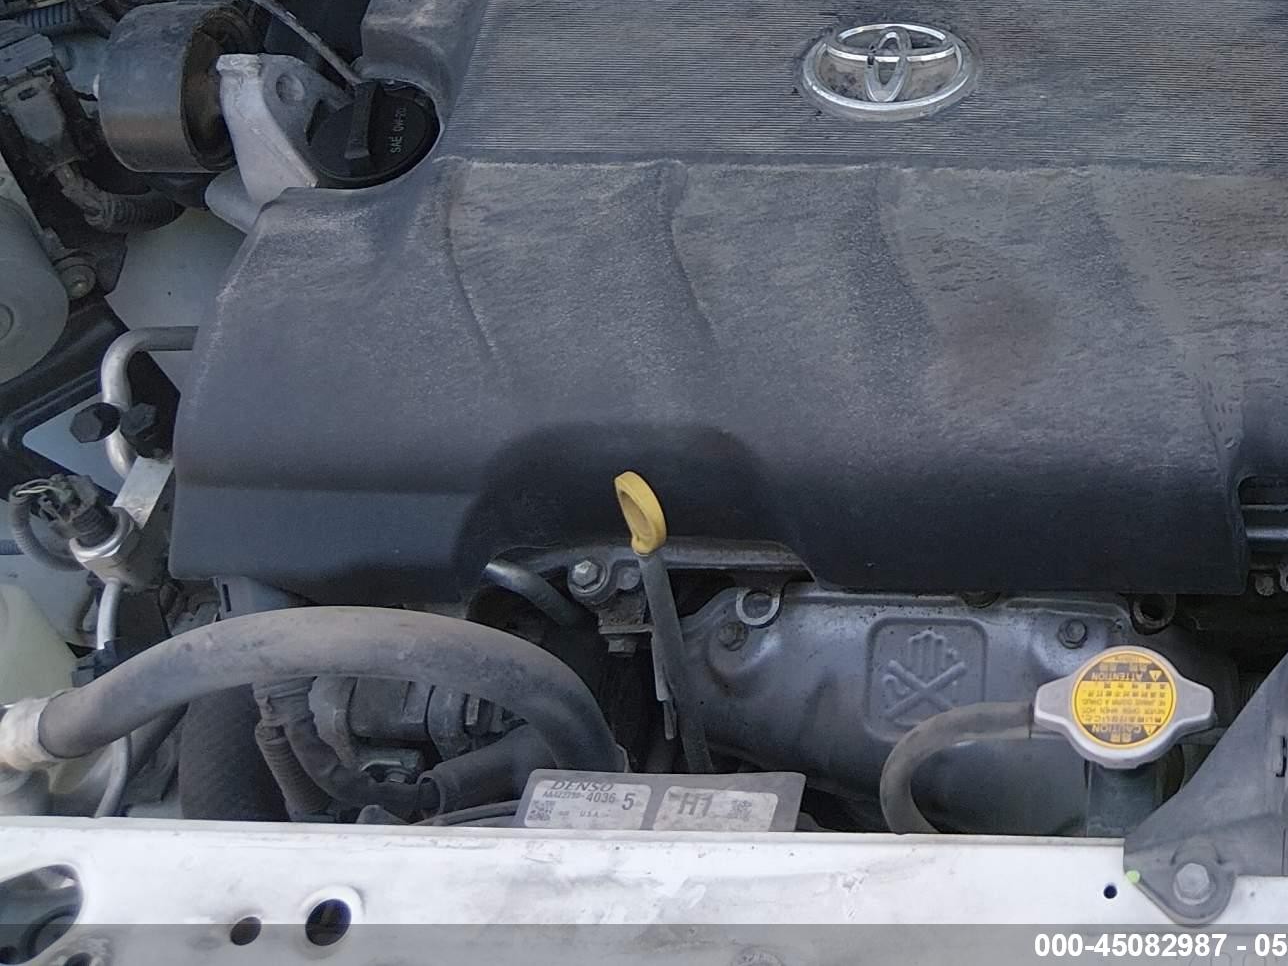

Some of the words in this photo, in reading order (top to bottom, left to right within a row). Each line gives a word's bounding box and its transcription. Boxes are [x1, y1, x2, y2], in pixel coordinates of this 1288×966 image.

[390, 136, 403, 153] SAE
[1091, 672, 1143, 681] ATTENTION
[1091, 724, 1142, 734] CAUTION
[551, 779, 614, 792] DENSO
[622, 792, 637, 811] 5
